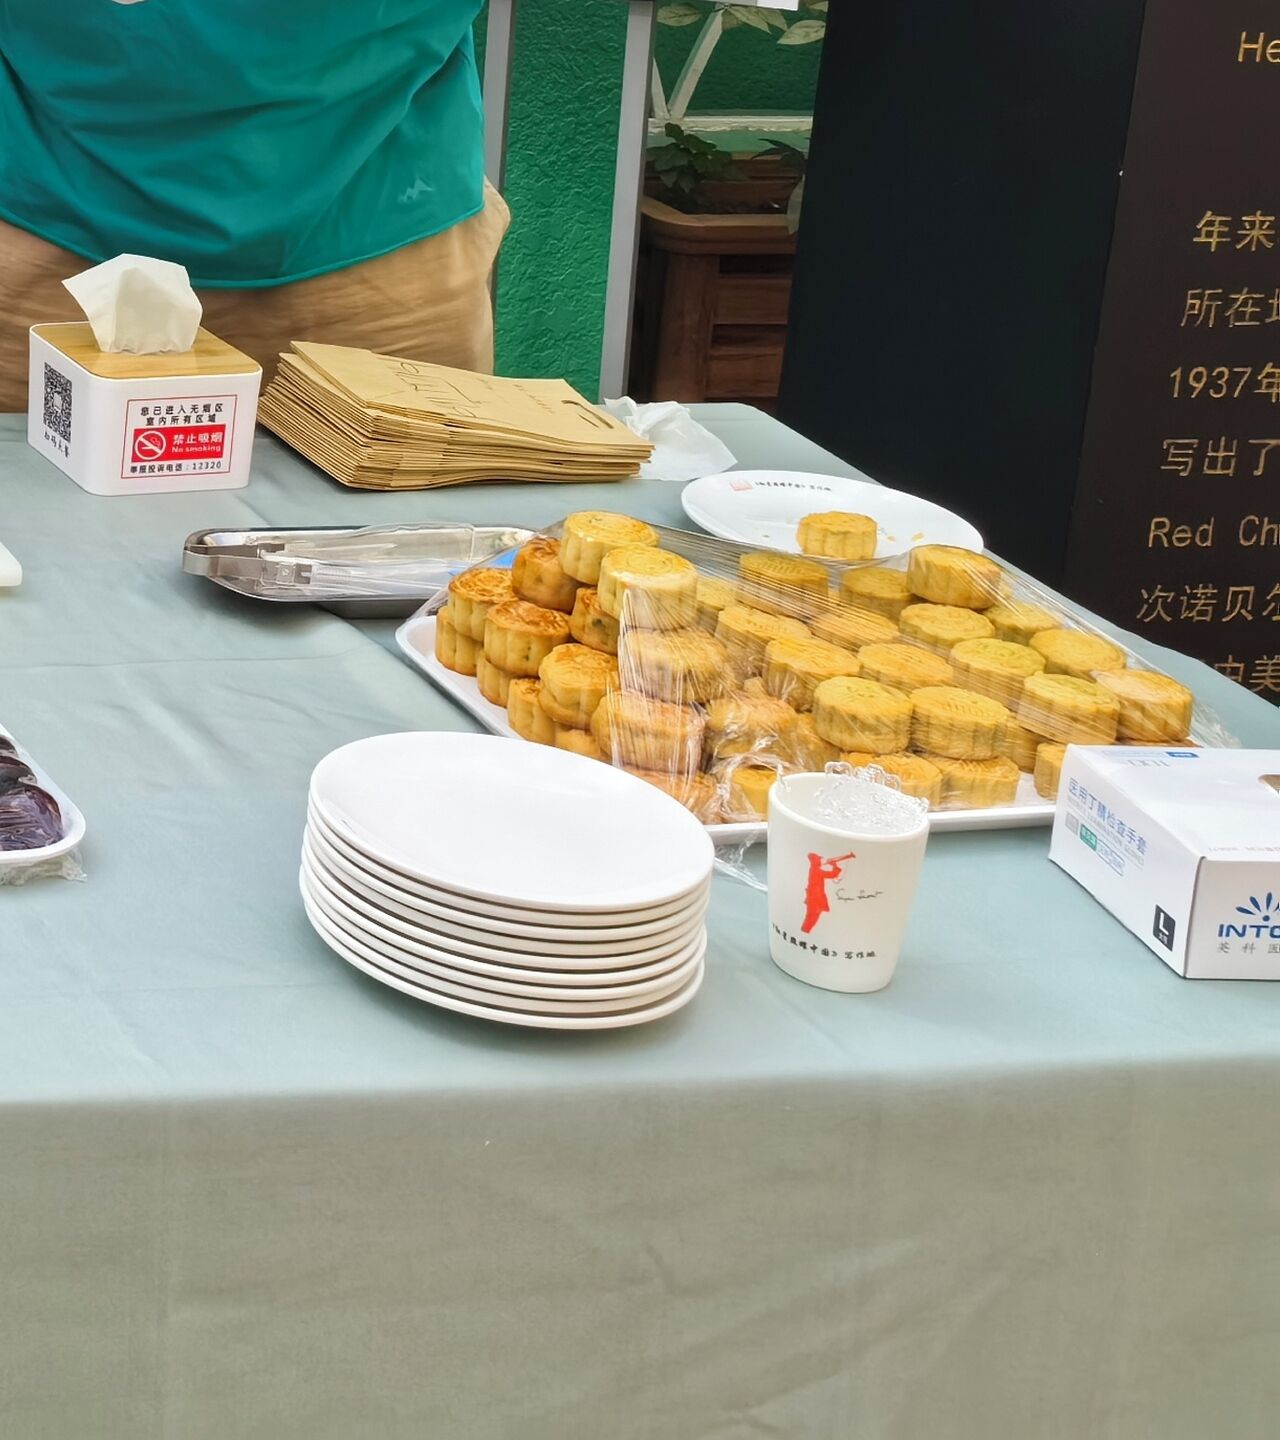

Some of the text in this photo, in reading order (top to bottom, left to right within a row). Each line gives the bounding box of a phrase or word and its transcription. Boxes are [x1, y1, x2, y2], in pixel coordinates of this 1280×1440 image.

[173, 431, 224, 446] 禁止吸烟
[171, 444, 222, 454] No smoking
[1148, 516, 1216, 548] Red
[1158, 911, 1170, 936] L
